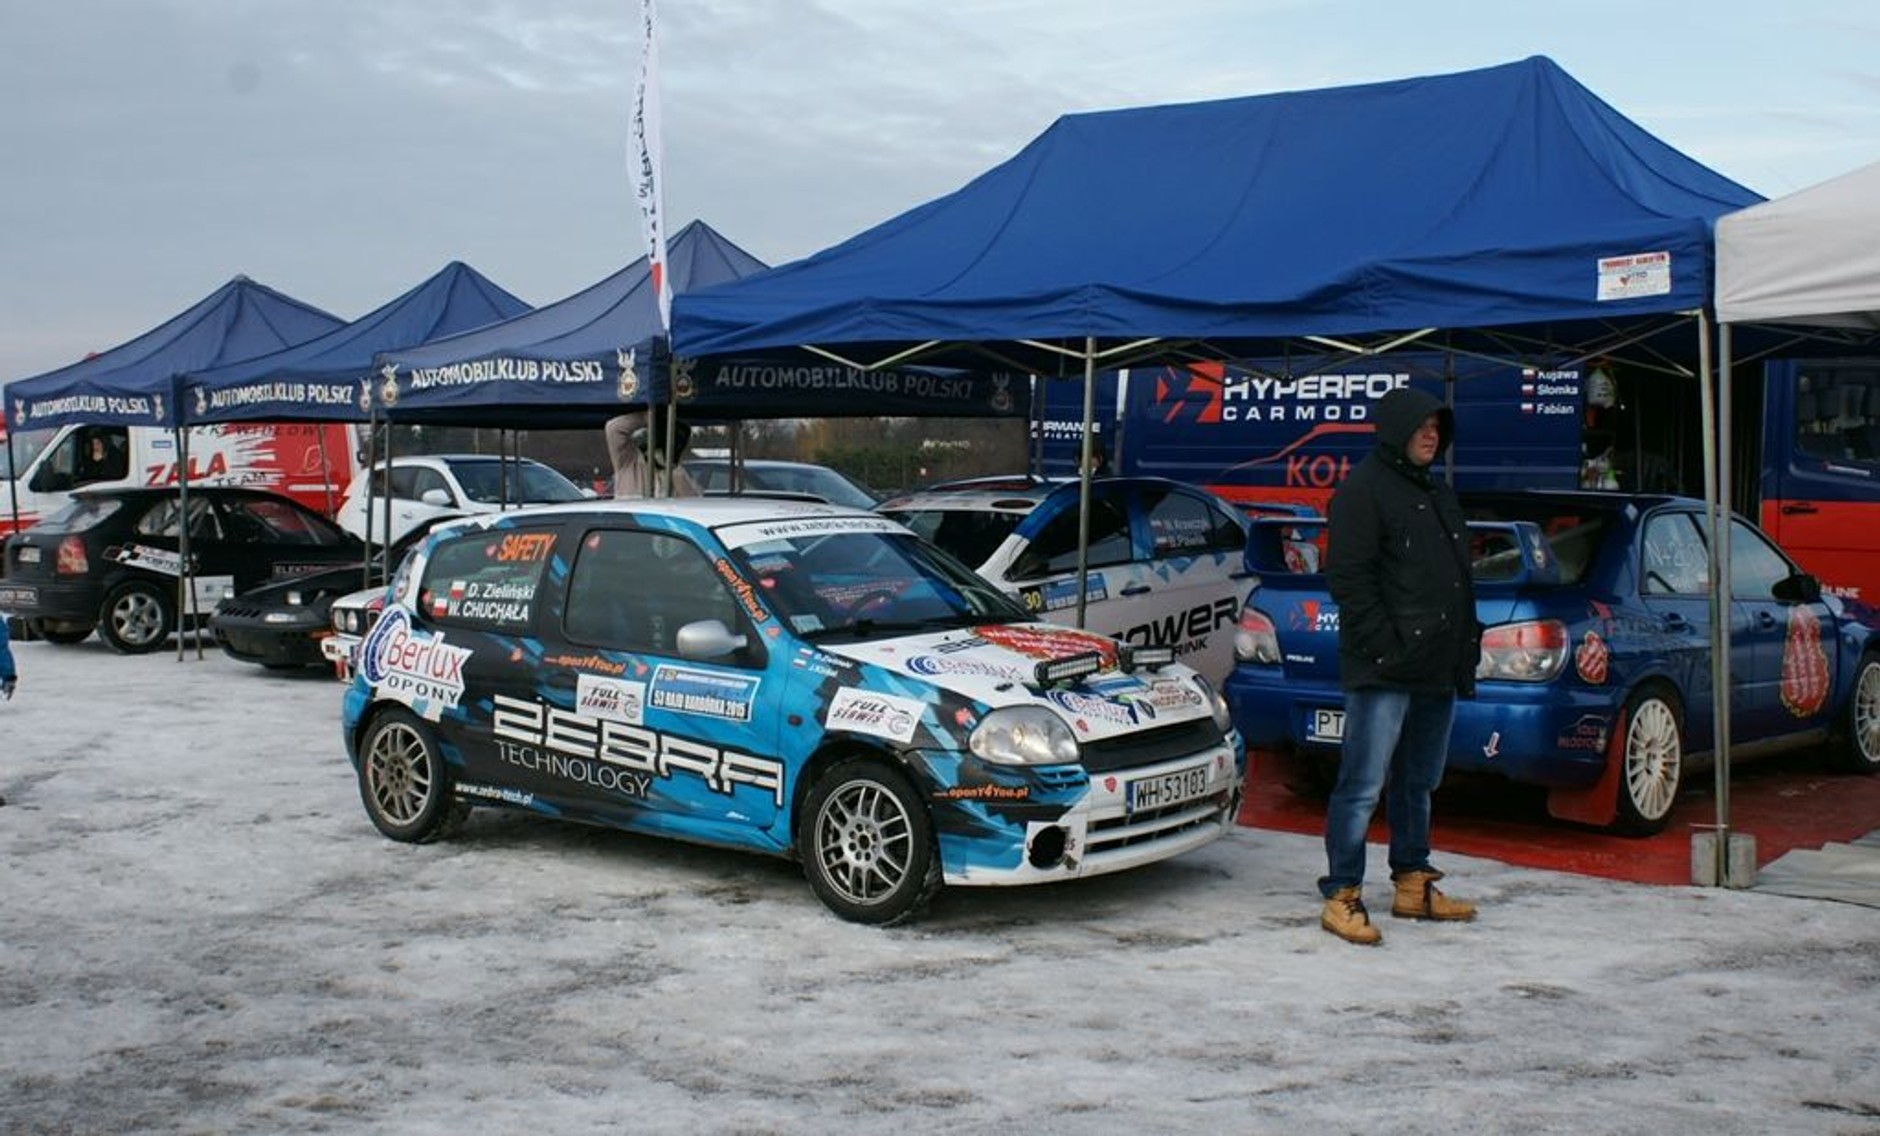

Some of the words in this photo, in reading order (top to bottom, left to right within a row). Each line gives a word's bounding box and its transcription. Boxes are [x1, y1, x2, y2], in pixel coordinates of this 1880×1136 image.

[411, 358, 540, 389] AUTOMOBILKLUB
[542, 361, 603, 382] POLSKI
[716, 366, 898, 393] AUTOMOBILKLUB
[904, 375, 973, 399] POLSKI
[30, 395, 106, 418] AUTOMOBILKLUB
[107, 397, 150, 415] POLSKI
[211, 383, 305, 408] AUTOMOBILKLUB
[307, 385, 354, 405] POLSKI
[1223, 405, 1367, 421] CARMOD
[1536, 402, 1575, 415] Fabian
[146, 451, 227, 487] ZALA
[213, 471, 268, 487] TEAM
[498, 533, 558, 562] SAFETY
[467, 582, 481, 598] D.
[483, 582, 536, 599] Zieliński
[1023, 590, 1042, 610] 30
[448, 600, 460, 617] W.
[463, 600, 529, 622] CHUCHAŁA
[1316, 612, 1340, 624] HY
[387, 630, 466, 684] Berlux
[1173, 636, 1208, 657] RINK
[387, 674, 459, 705] OPONY
[590, 686, 620, 698] FULL
[581, 696, 619, 711] SERWIS
[850, 700, 888, 713] FULL
[1317, 712, 1345, 737] PT
[494, 694, 784, 808] ZEBRA
[493, 740, 651, 798] TECHNOLOGY
[1136, 778, 1160, 808] WH
